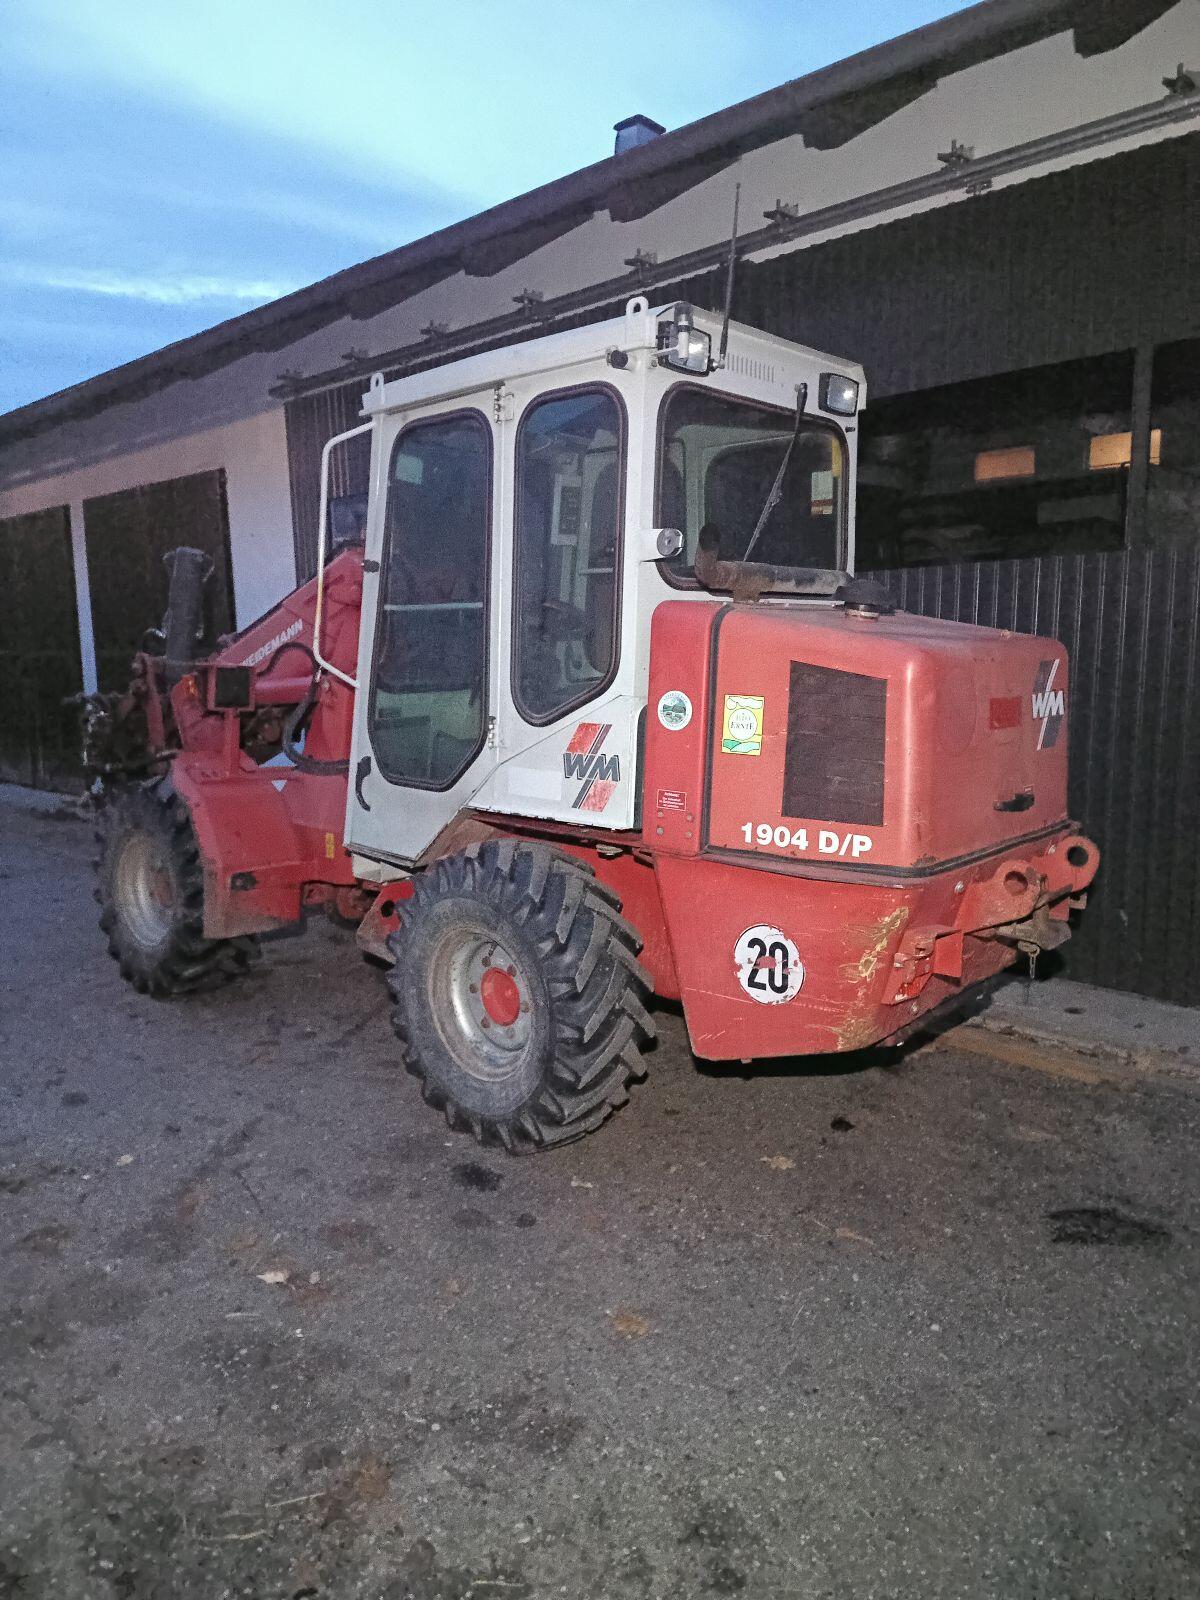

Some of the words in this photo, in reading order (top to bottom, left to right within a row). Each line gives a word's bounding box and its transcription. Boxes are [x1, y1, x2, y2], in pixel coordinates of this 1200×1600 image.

[1032, 690, 1065, 719] WM
[563, 752, 621, 782] WM
[741, 822, 809, 850] 1904
[818, 830, 873, 858] D/P
[747, 937, 790, 994] 20
